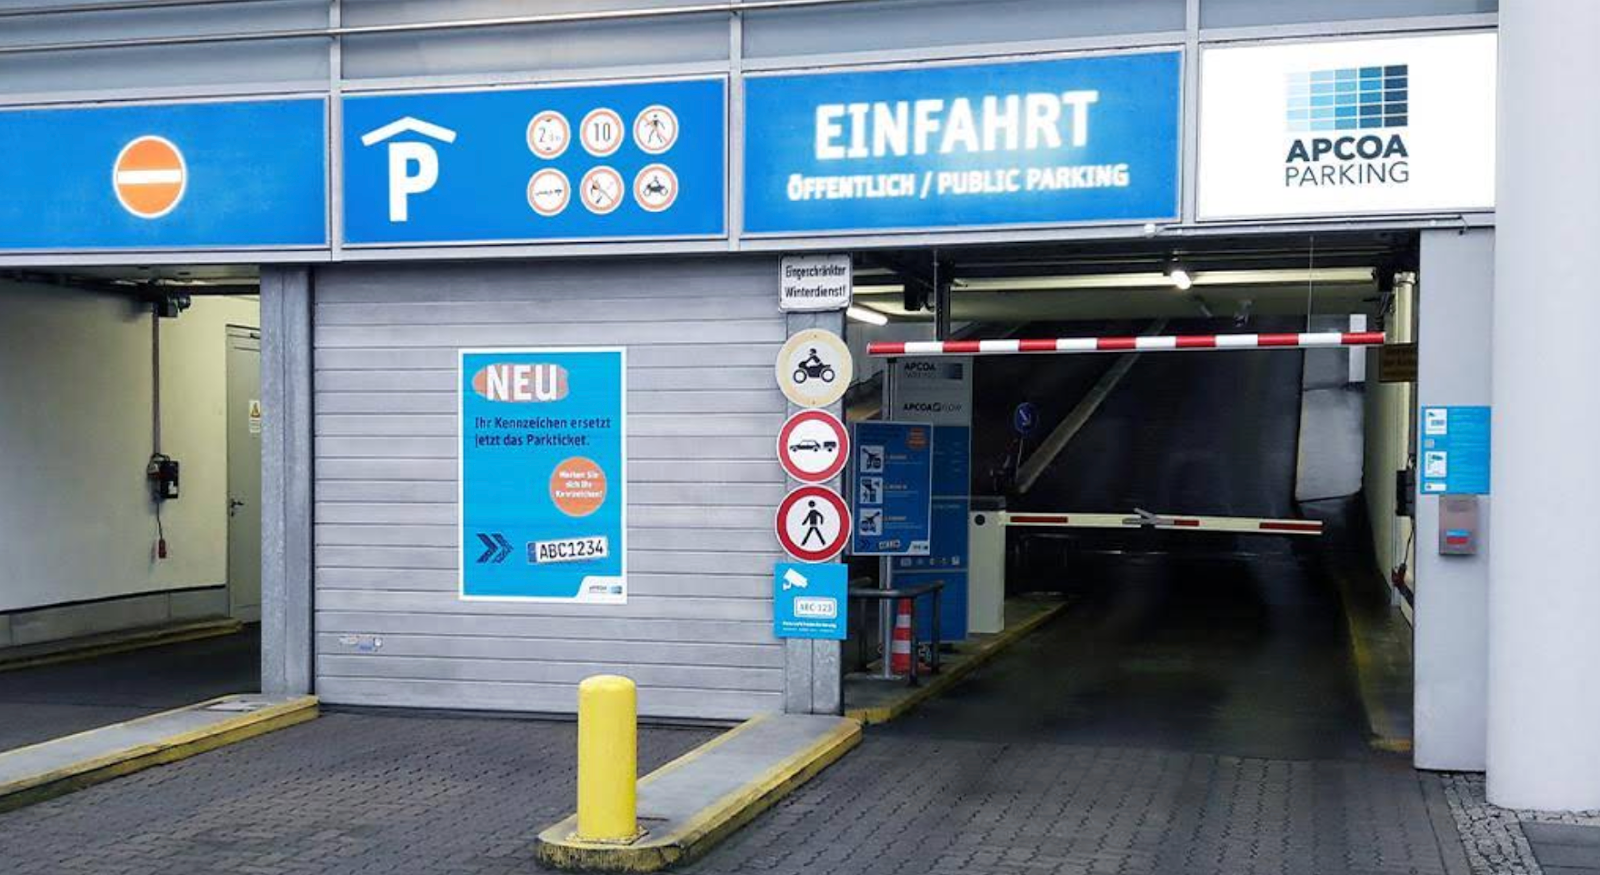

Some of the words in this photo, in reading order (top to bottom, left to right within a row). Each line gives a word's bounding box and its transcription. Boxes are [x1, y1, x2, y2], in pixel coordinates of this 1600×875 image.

[593, 122, 611, 142] 10
[815, 91, 1099, 160] EINFAHRT
[1285, 134, 1409, 163] APCOA
[388, 141, 439, 222] P
[787, 171, 915, 201] ÖFFENTLICH
[938, 167, 1019, 195] PUBLIC
[1026, 163, 1129, 190] PARKING
[1285, 161, 1409, 187] PARKING
[785, 263, 847, 281] Eingeschränkter
[785, 285, 846, 299] Winterdienst!
[904, 362, 936, 371] APCOA
[486, 364, 557, 401] NEU
[903, 402, 932, 412] APCOA
[475, 416, 492, 429] Ihr
[494, 416, 567, 429] Kennzeichen
[570, 415, 611, 429] ersetzt
[474, 434, 500, 448] jetzt
[503, 433, 523, 446] das
[539, 539, 603, 560] ABC1234
